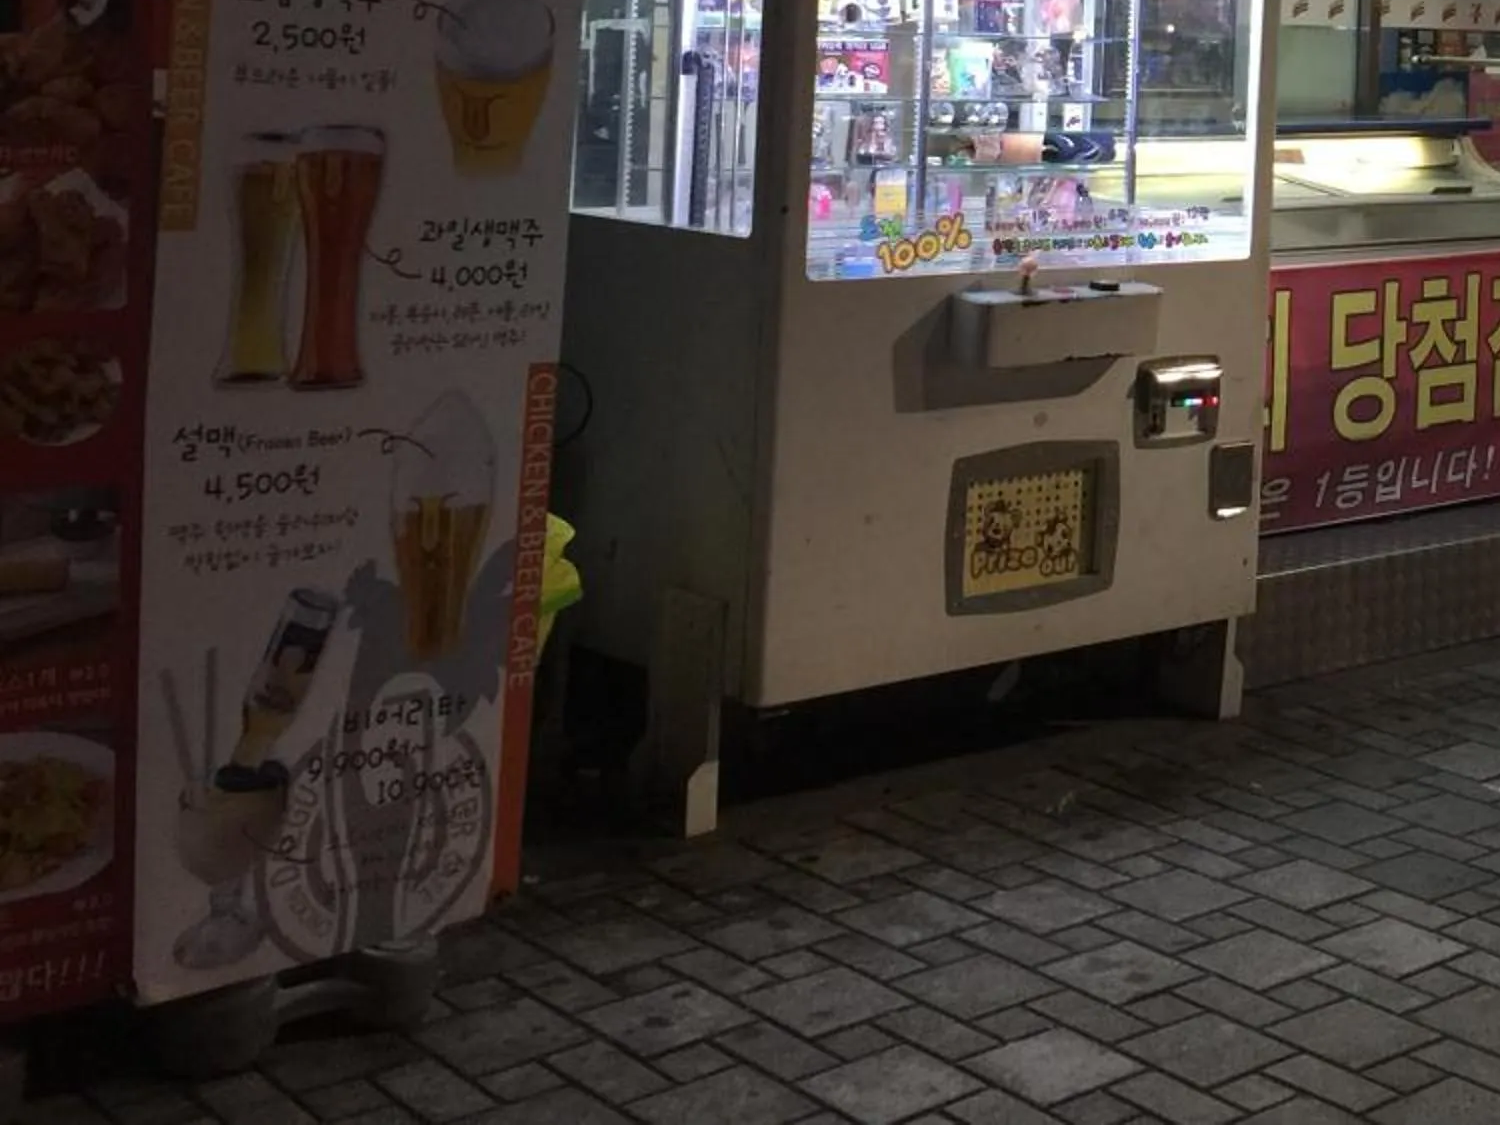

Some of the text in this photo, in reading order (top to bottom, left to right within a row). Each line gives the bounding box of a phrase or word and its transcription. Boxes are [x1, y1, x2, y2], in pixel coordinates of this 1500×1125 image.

[253, 20, 366, 55] 2,500원
[168, 48, 204, 123] BEER
[163, 139, 196, 224] CAFE
[419, 217, 544, 251] 과일생맥주
[876, 212, 972, 273] 100%
[430, 259, 528, 292] 4,000원
[204, 464, 321, 504] 4,500원
[1316, 444, 1495, 510] 1등입니다!
[508, 374, 558, 688] CHICKEN & BEER CAFE
